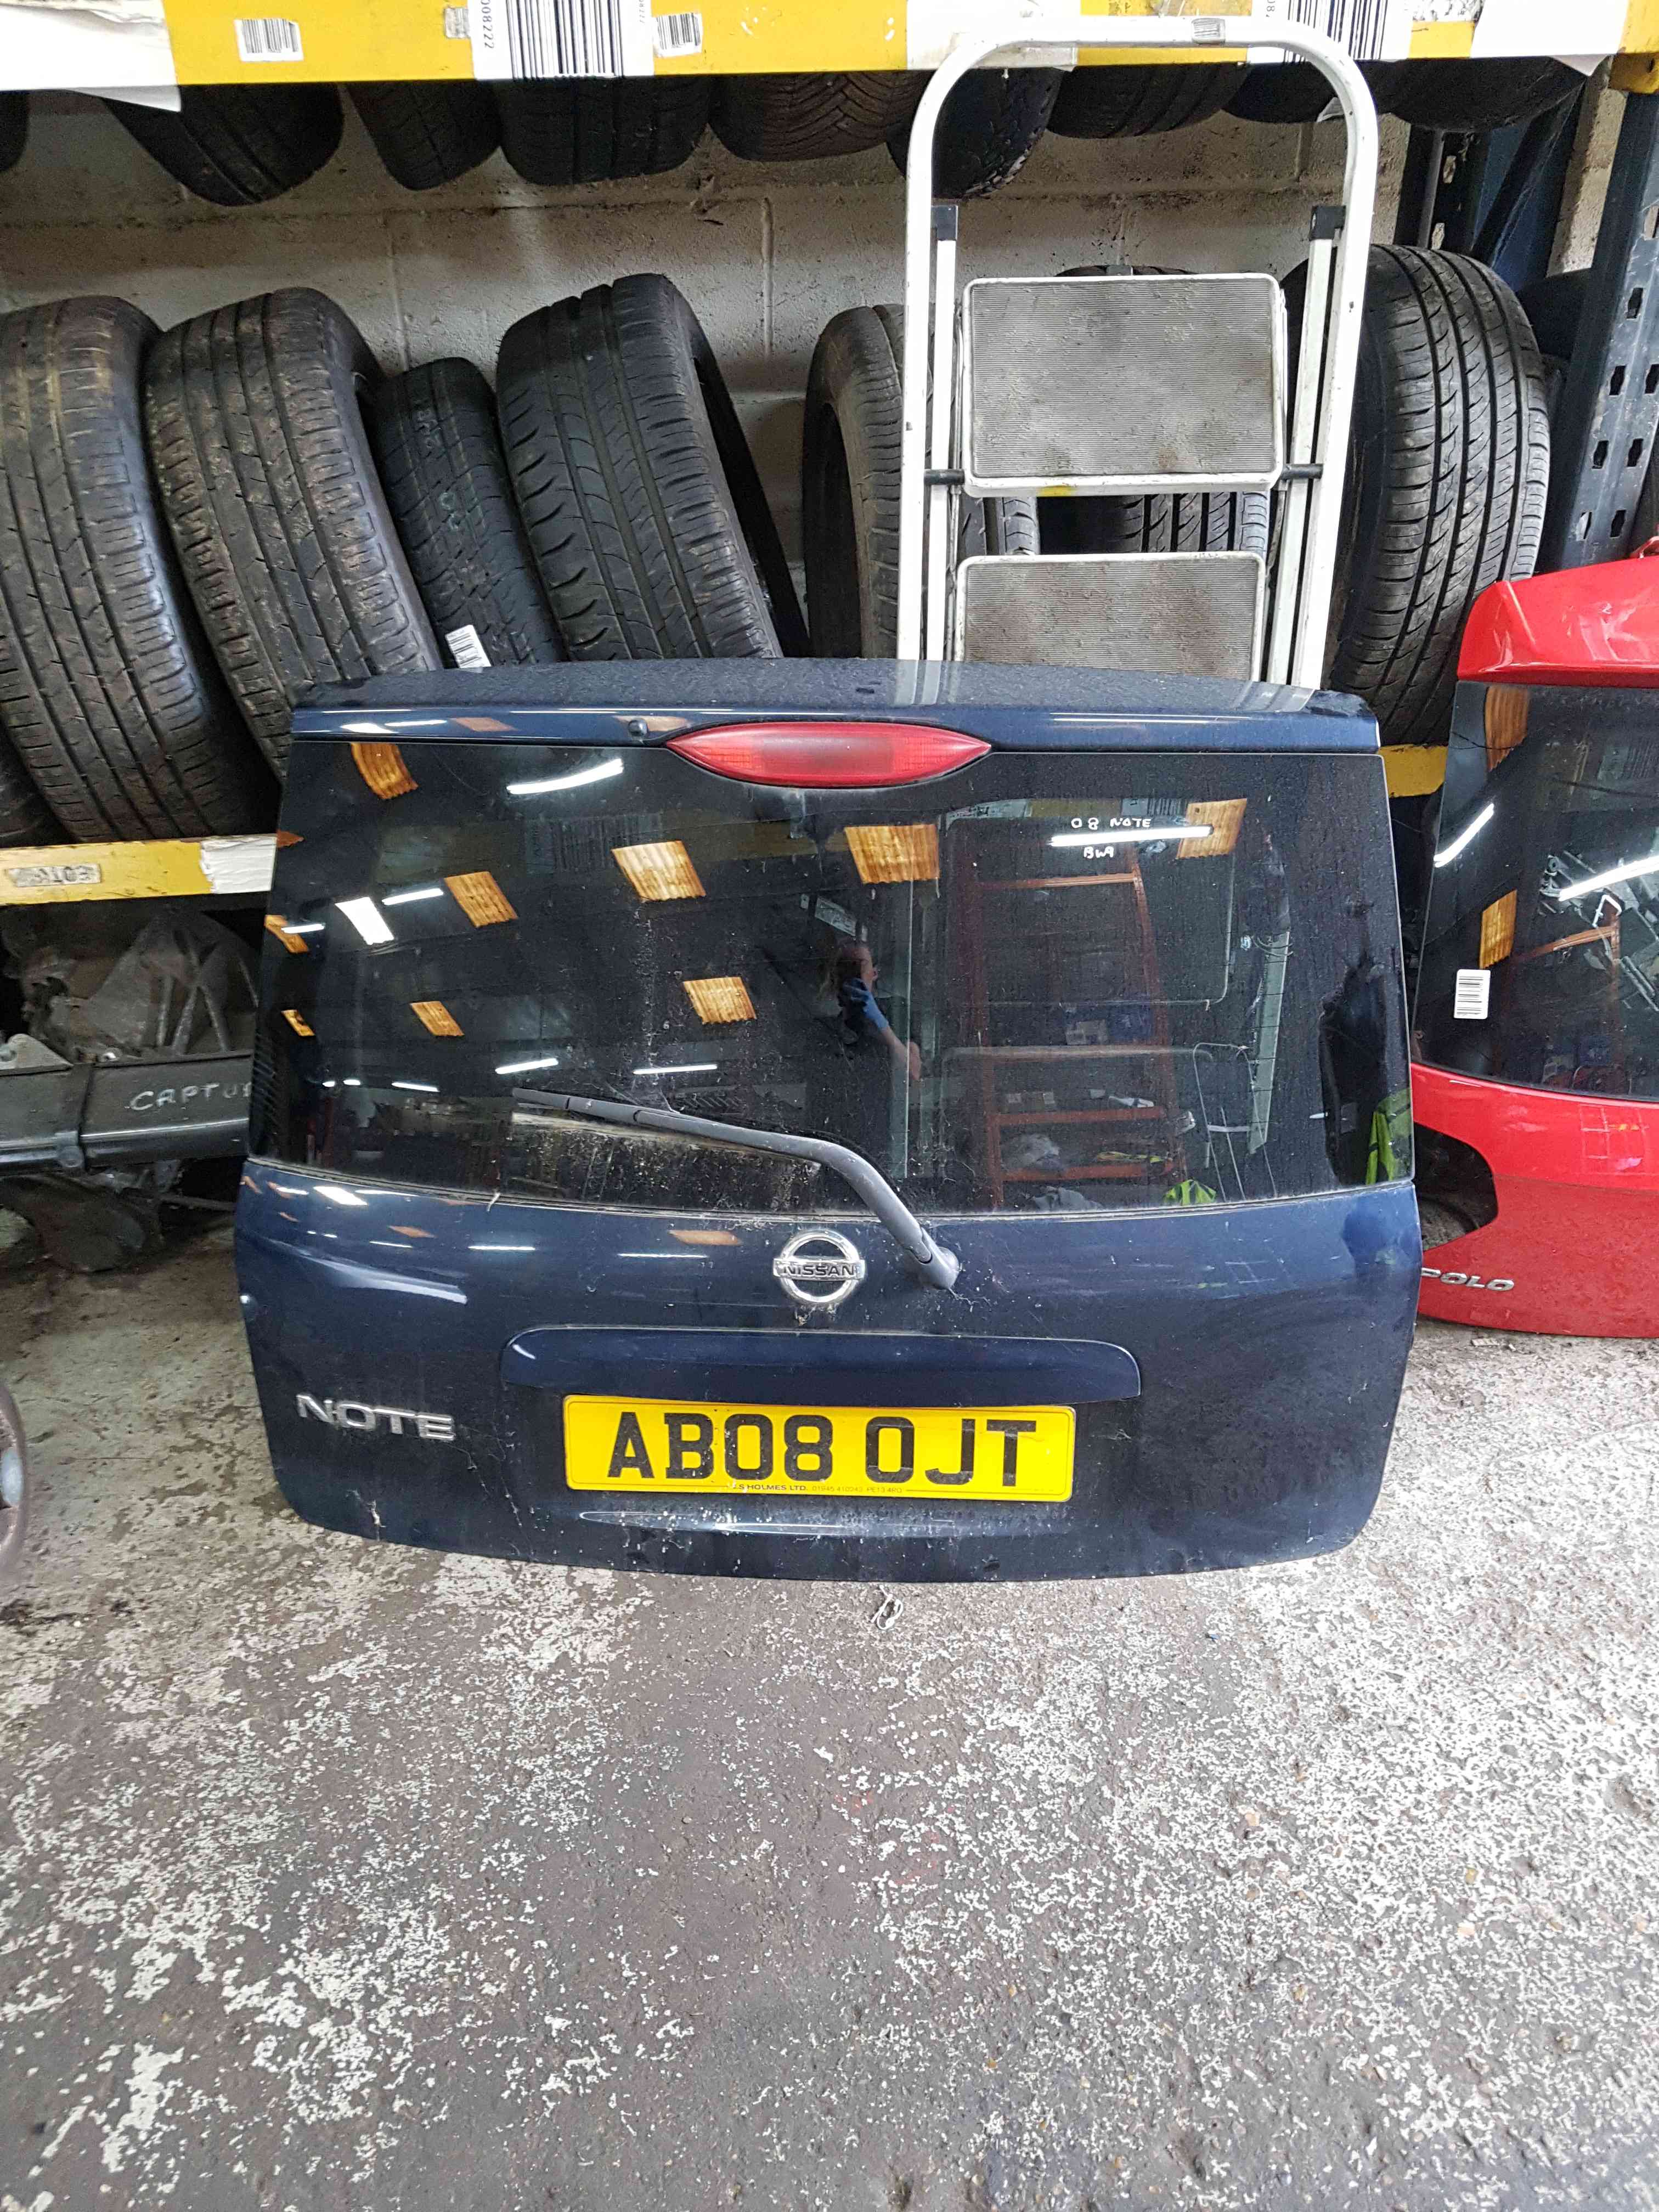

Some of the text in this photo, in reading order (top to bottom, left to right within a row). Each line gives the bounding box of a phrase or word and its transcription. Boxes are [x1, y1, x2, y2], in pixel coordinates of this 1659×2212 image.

[1110, 817, 1152, 828] NOTE
[783, 1264, 855, 1277] NISSAN
[296, 1394, 455, 1441] NOTE
[607, 1411, 1037, 1487] AB08 OJT
